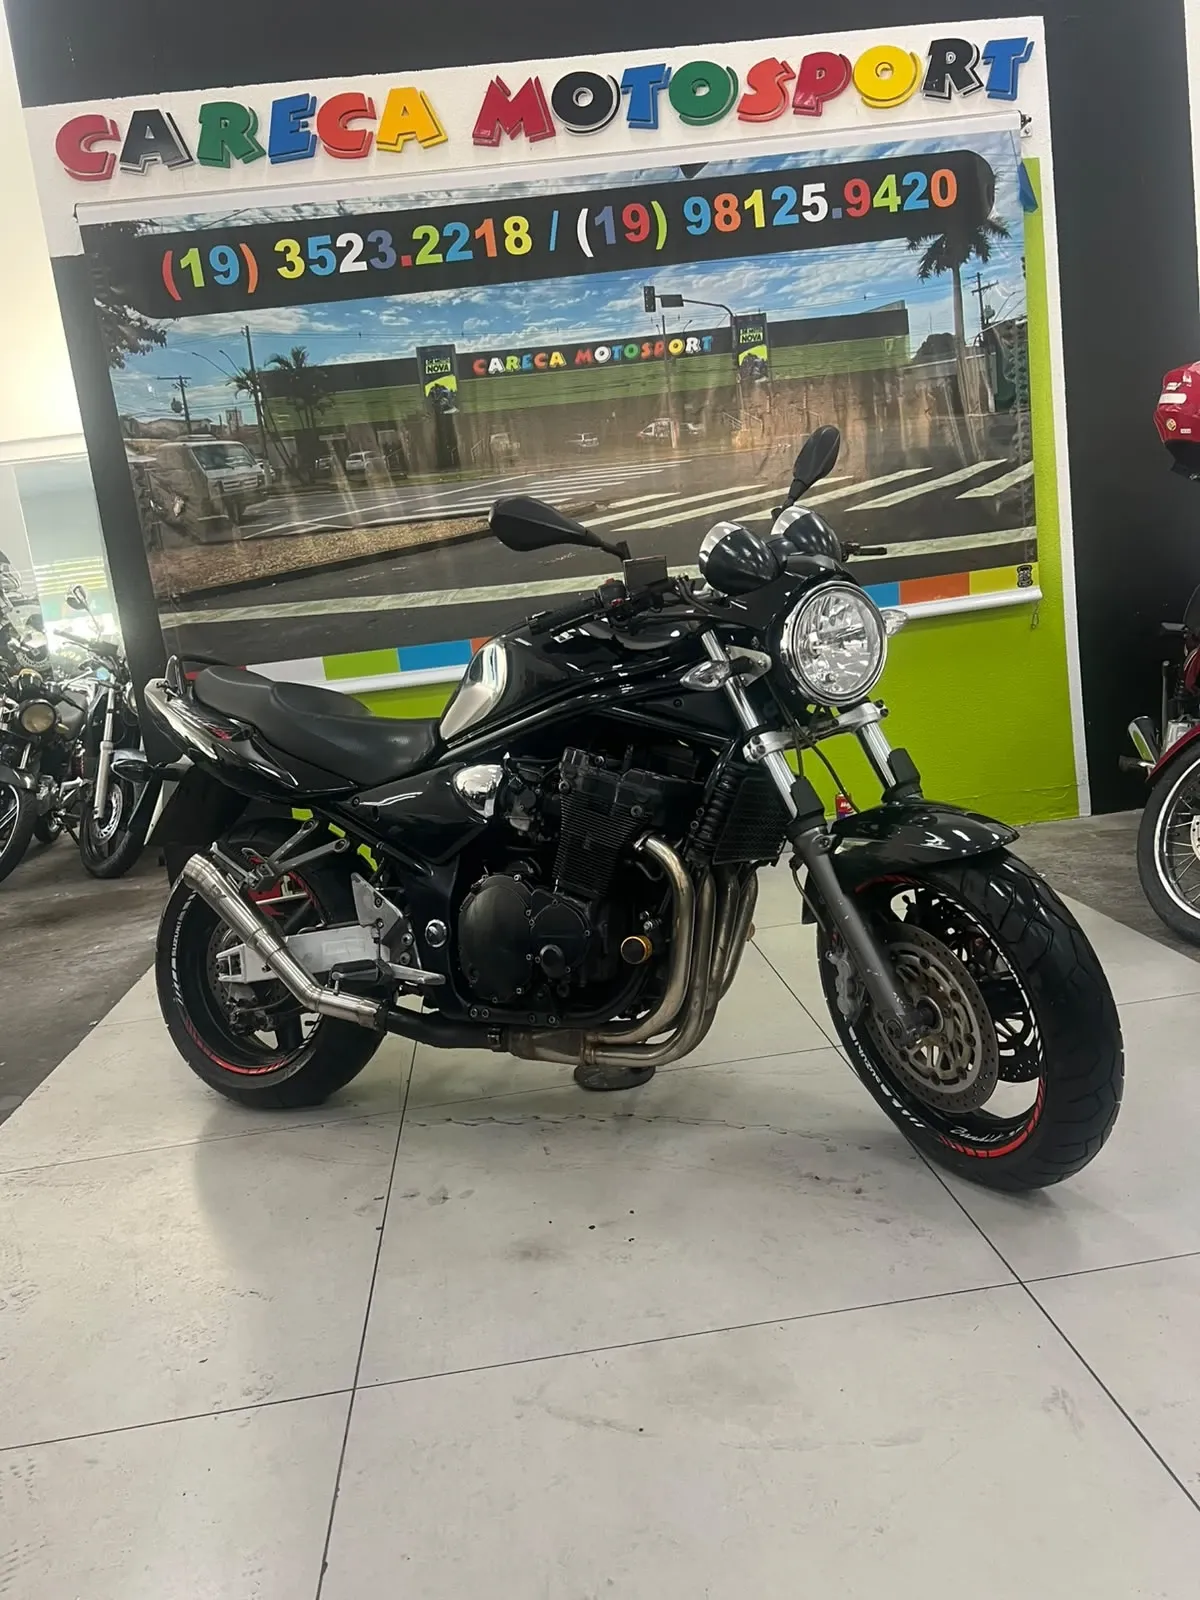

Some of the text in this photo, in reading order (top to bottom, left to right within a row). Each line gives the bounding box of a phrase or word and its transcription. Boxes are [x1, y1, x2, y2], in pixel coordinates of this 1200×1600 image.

[55, 36, 1034, 182] CARECA MOTOSPORT
[161, 168, 958, 301] (19) 3523.2218 / (19) 98125.9420
[472, 335, 713, 376] CARECA MOTOSPORT
[741, 333, 761, 342] NOVA
[427, 364, 449, 373] NOVA
[171, 921, 182, 957] SUZUKI
[854, 1040, 881, 1084] SUZUKI
